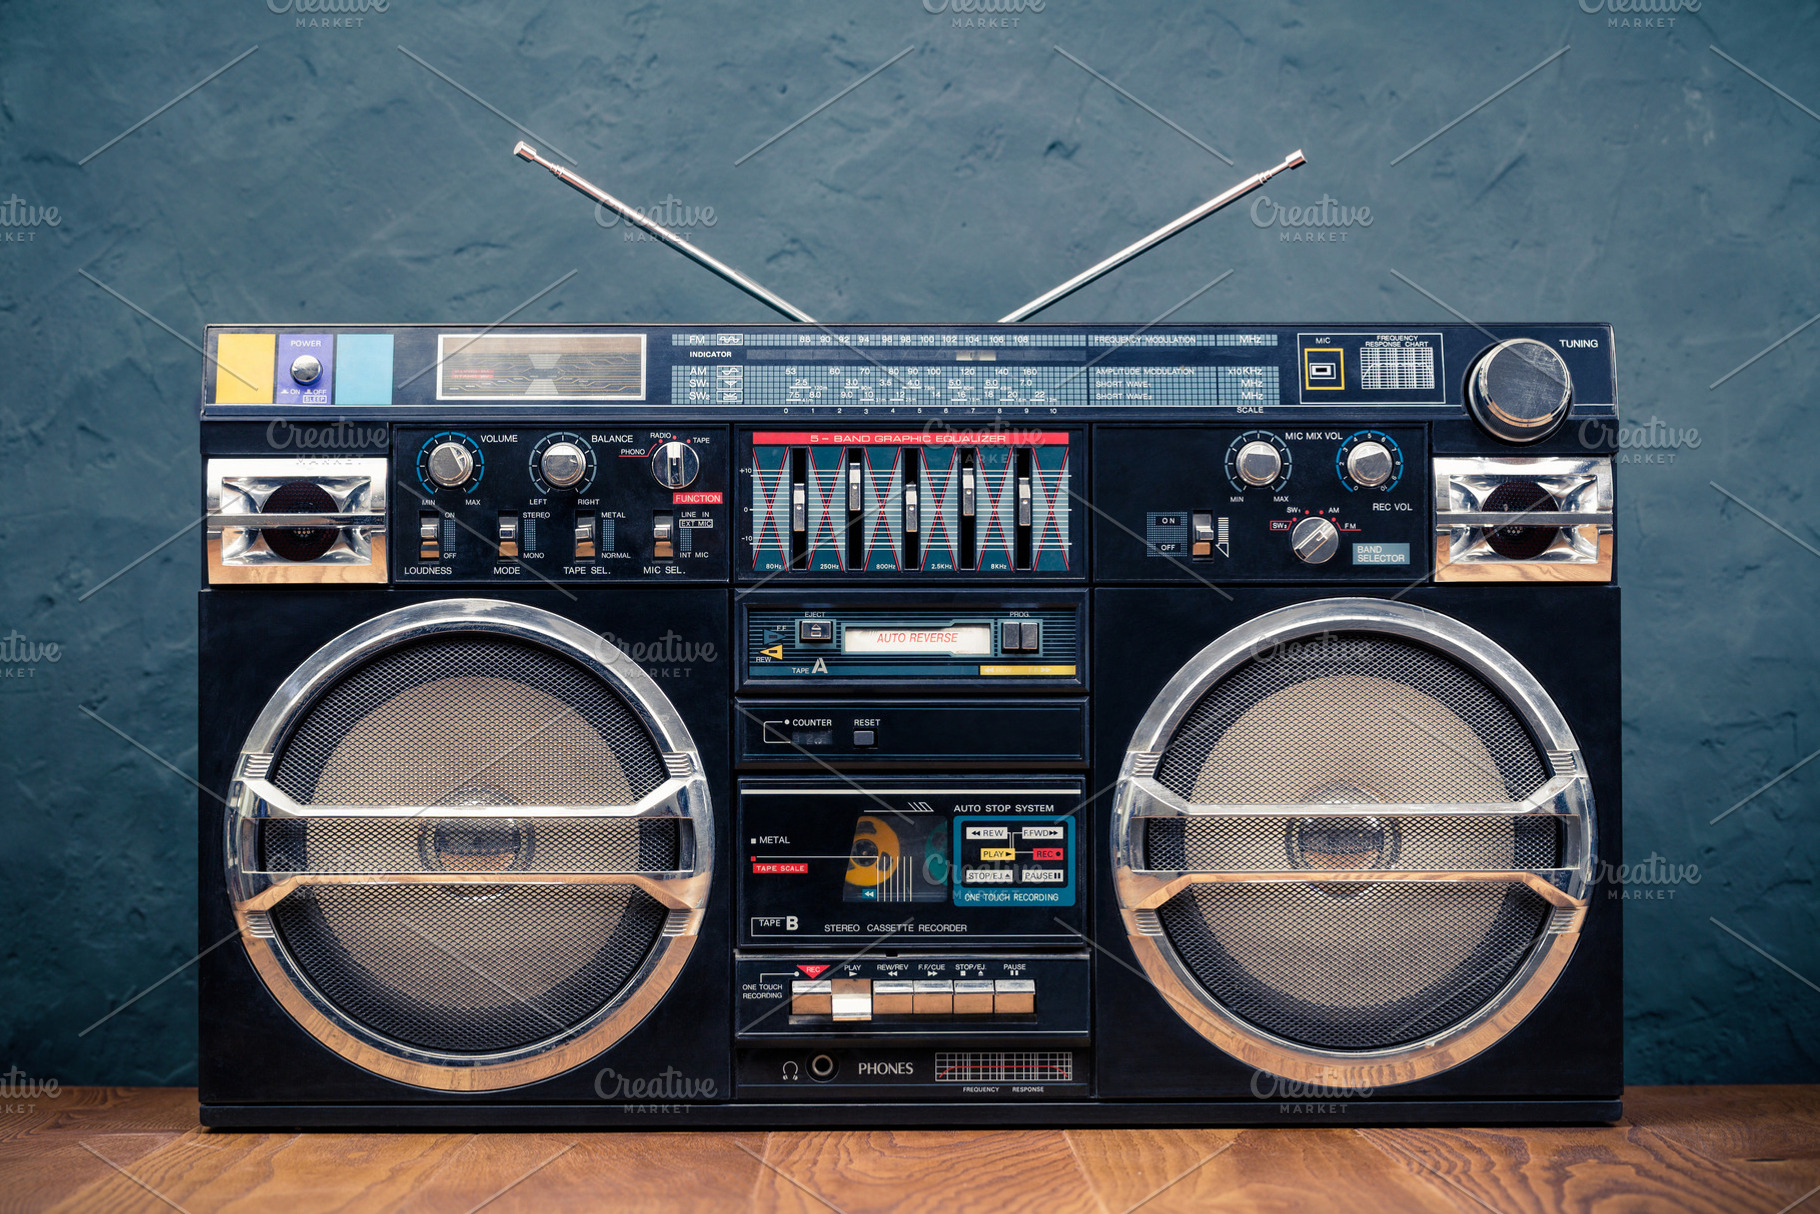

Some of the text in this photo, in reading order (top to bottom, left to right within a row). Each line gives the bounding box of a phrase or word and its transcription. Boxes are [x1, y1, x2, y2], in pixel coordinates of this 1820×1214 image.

[689, 335, 705, 344] FM
[1094, 336, 1196, 344] FREQUENCY MODULATION
[1239, 335, 1262, 344] MHz
[1559, 339, 1599, 348] TUNING
[689, 367, 707, 376] AM
[785, 367, 1038, 376] 53 60 70 80 90 100 120 140 160
[1095, 368, 1195, 376] AMPLITUDE MODULATION
[795, 378, 808, 386] 2.5
[879, 379, 892, 387] 3.5
[907, 379, 920, 387] 4.0
[948, 379, 962, 387] 5.0
[985, 379, 998, 387] 6.0
[1019, 379, 1033, 387] 7.0
[1241, 379, 1263, 388] MHz
[1241, 392, 1264, 400] MHz
[1237, 406, 1264, 414] SCALE
[480, 434, 518, 443] VOLUME
[591, 434, 634, 443] BALANCE
[810, 435, 1006, 443] 5 BAND GRAPHIC EQUALIZER
[1285, 432, 1344, 440] MIC MIX VOL
[675, 494, 721, 503] FUNCTION
[1372, 503, 1413, 511] REC VOL
[601, 511, 626, 519] METAL
[1357, 545, 1383, 553] BAND
[1357, 554, 1405, 562] SELECTOR
[404, 566, 452, 575] LOUDNESS
[493, 566, 521, 575] MODE
[563, 566, 611, 575] TAPE SEL.
[643, 566, 686, 574] MIC SEL.
[876, 633, 958, 643] AUTO REVERSE
[811, 657, 828, 674] A
[792, 719, 833, 727] COUNTER
[853, 718, 881, 726] RESET
[953, 804, 1054, 812] AUTO STOP SYSTEM
[759, 836, 790, 844] METAL
[964, 893, 1059, 902] ONE TOUCH RECORDING
[759, 915, 799, 931] TAPE B
[824, 924, 968, 932] STEREO CASSETTE RECORDER
[742, 992, 783, 1000] RECORDING
[858, 1062, 914, 1075] PHONES
